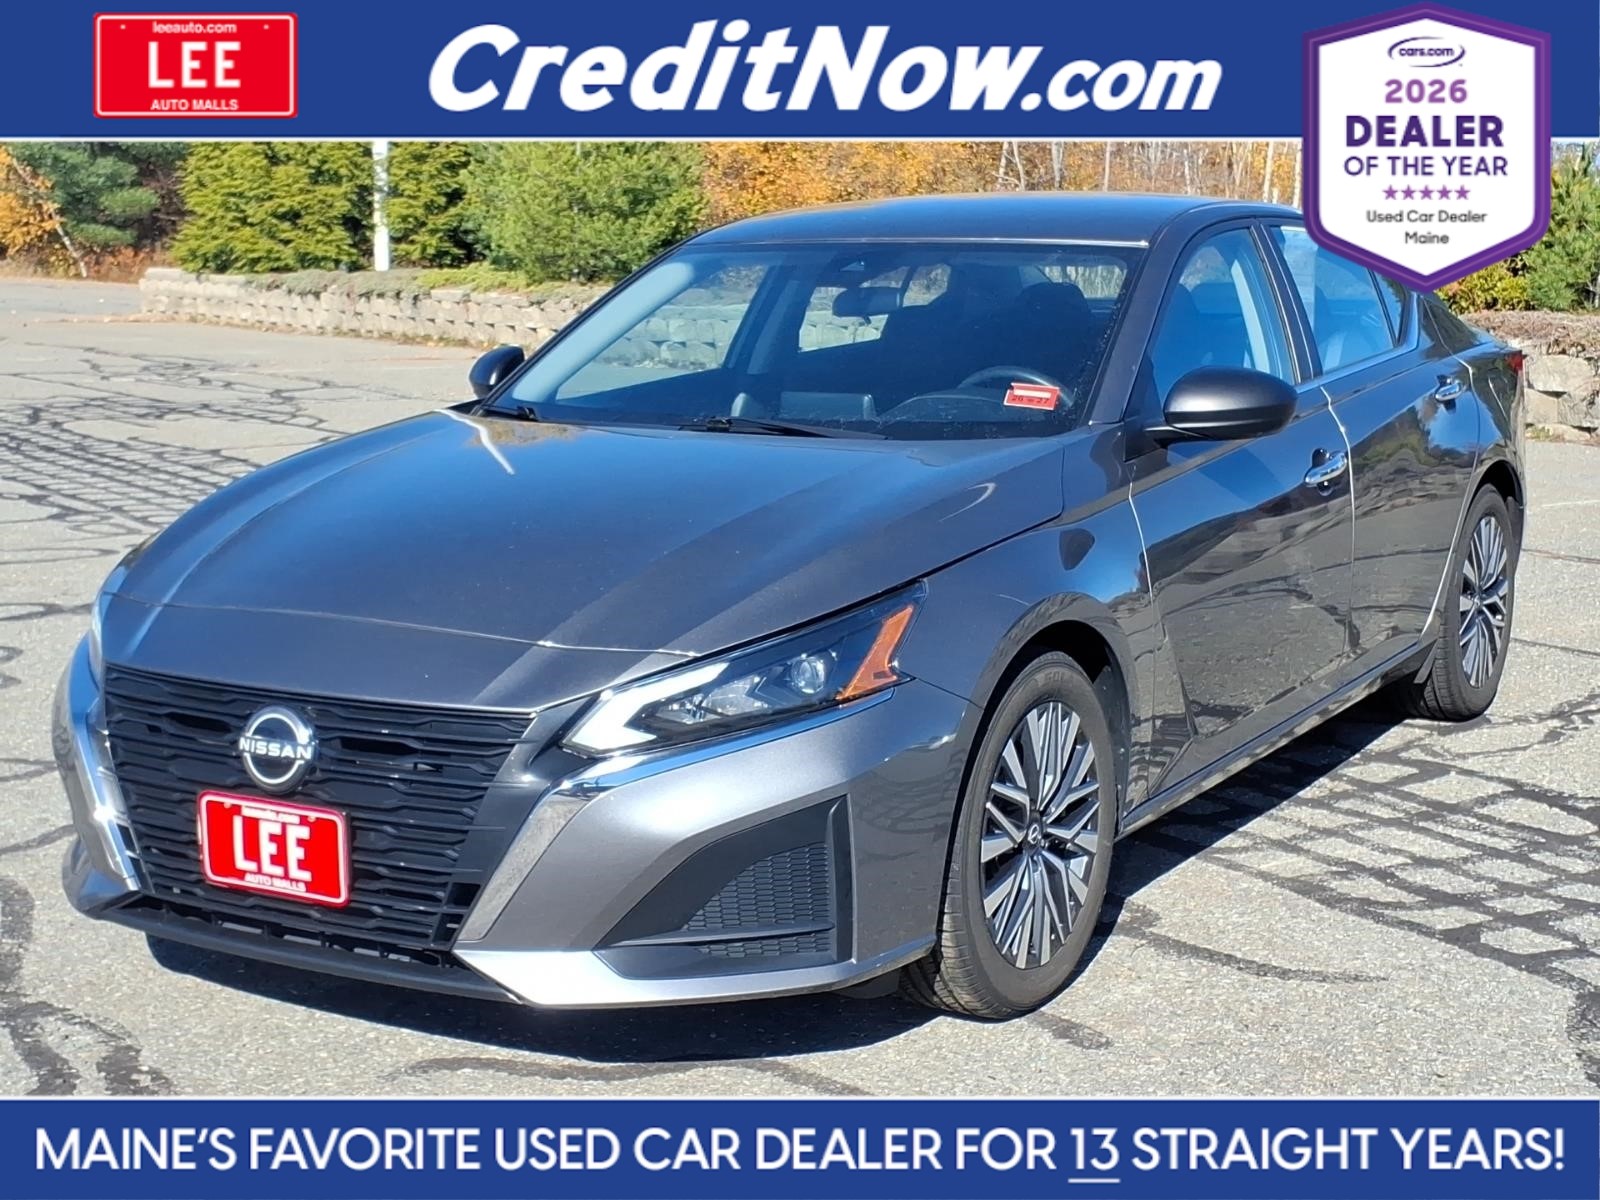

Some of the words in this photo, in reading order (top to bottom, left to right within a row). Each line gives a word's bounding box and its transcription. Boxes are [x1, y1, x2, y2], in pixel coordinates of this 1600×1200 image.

[239, 736, 313, 760] NISSAN
[232, 814, 313, 882] LEE
[244, 871, 273, 887] AUTO
